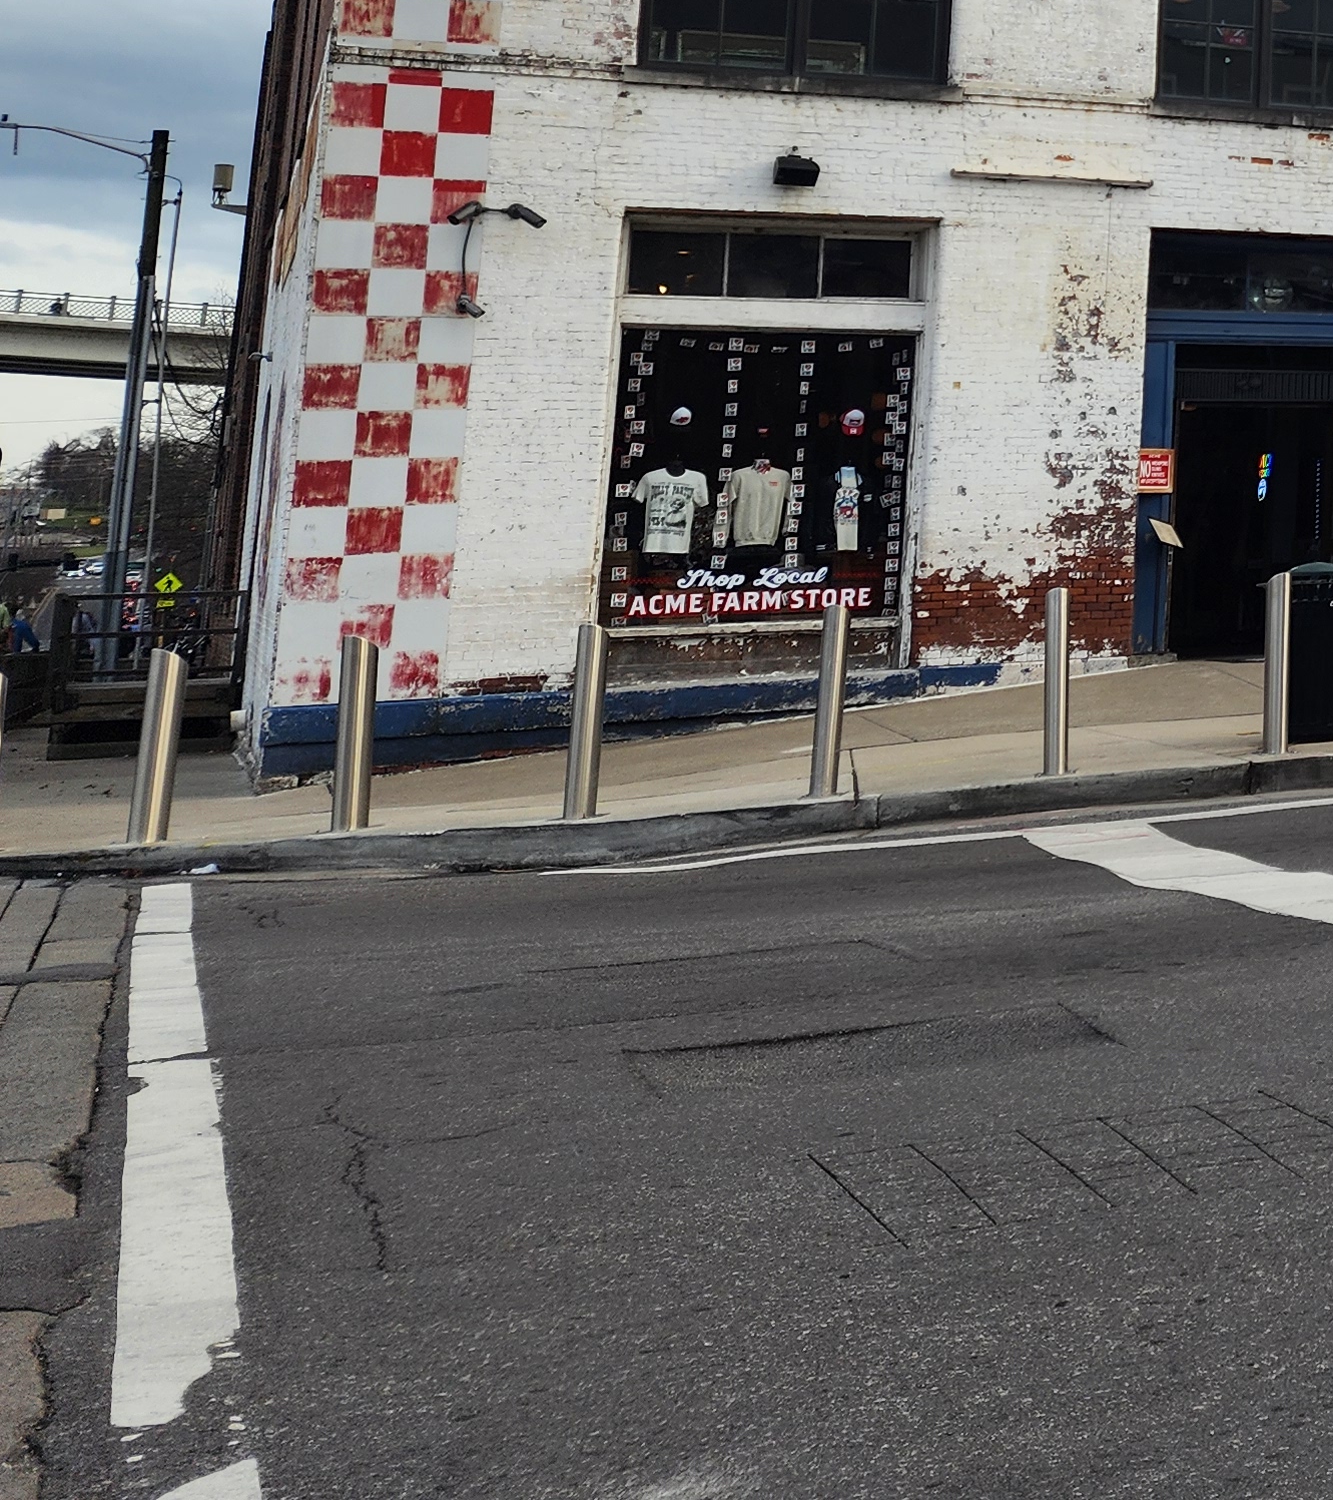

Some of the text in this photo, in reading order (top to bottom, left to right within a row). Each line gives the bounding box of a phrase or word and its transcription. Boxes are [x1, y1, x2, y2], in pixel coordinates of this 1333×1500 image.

[1140, 460, 1151, 478] NO
[677, 566, 829, 589] Shop Local
[628, 588, 872, 616] ACME FARM STORE
